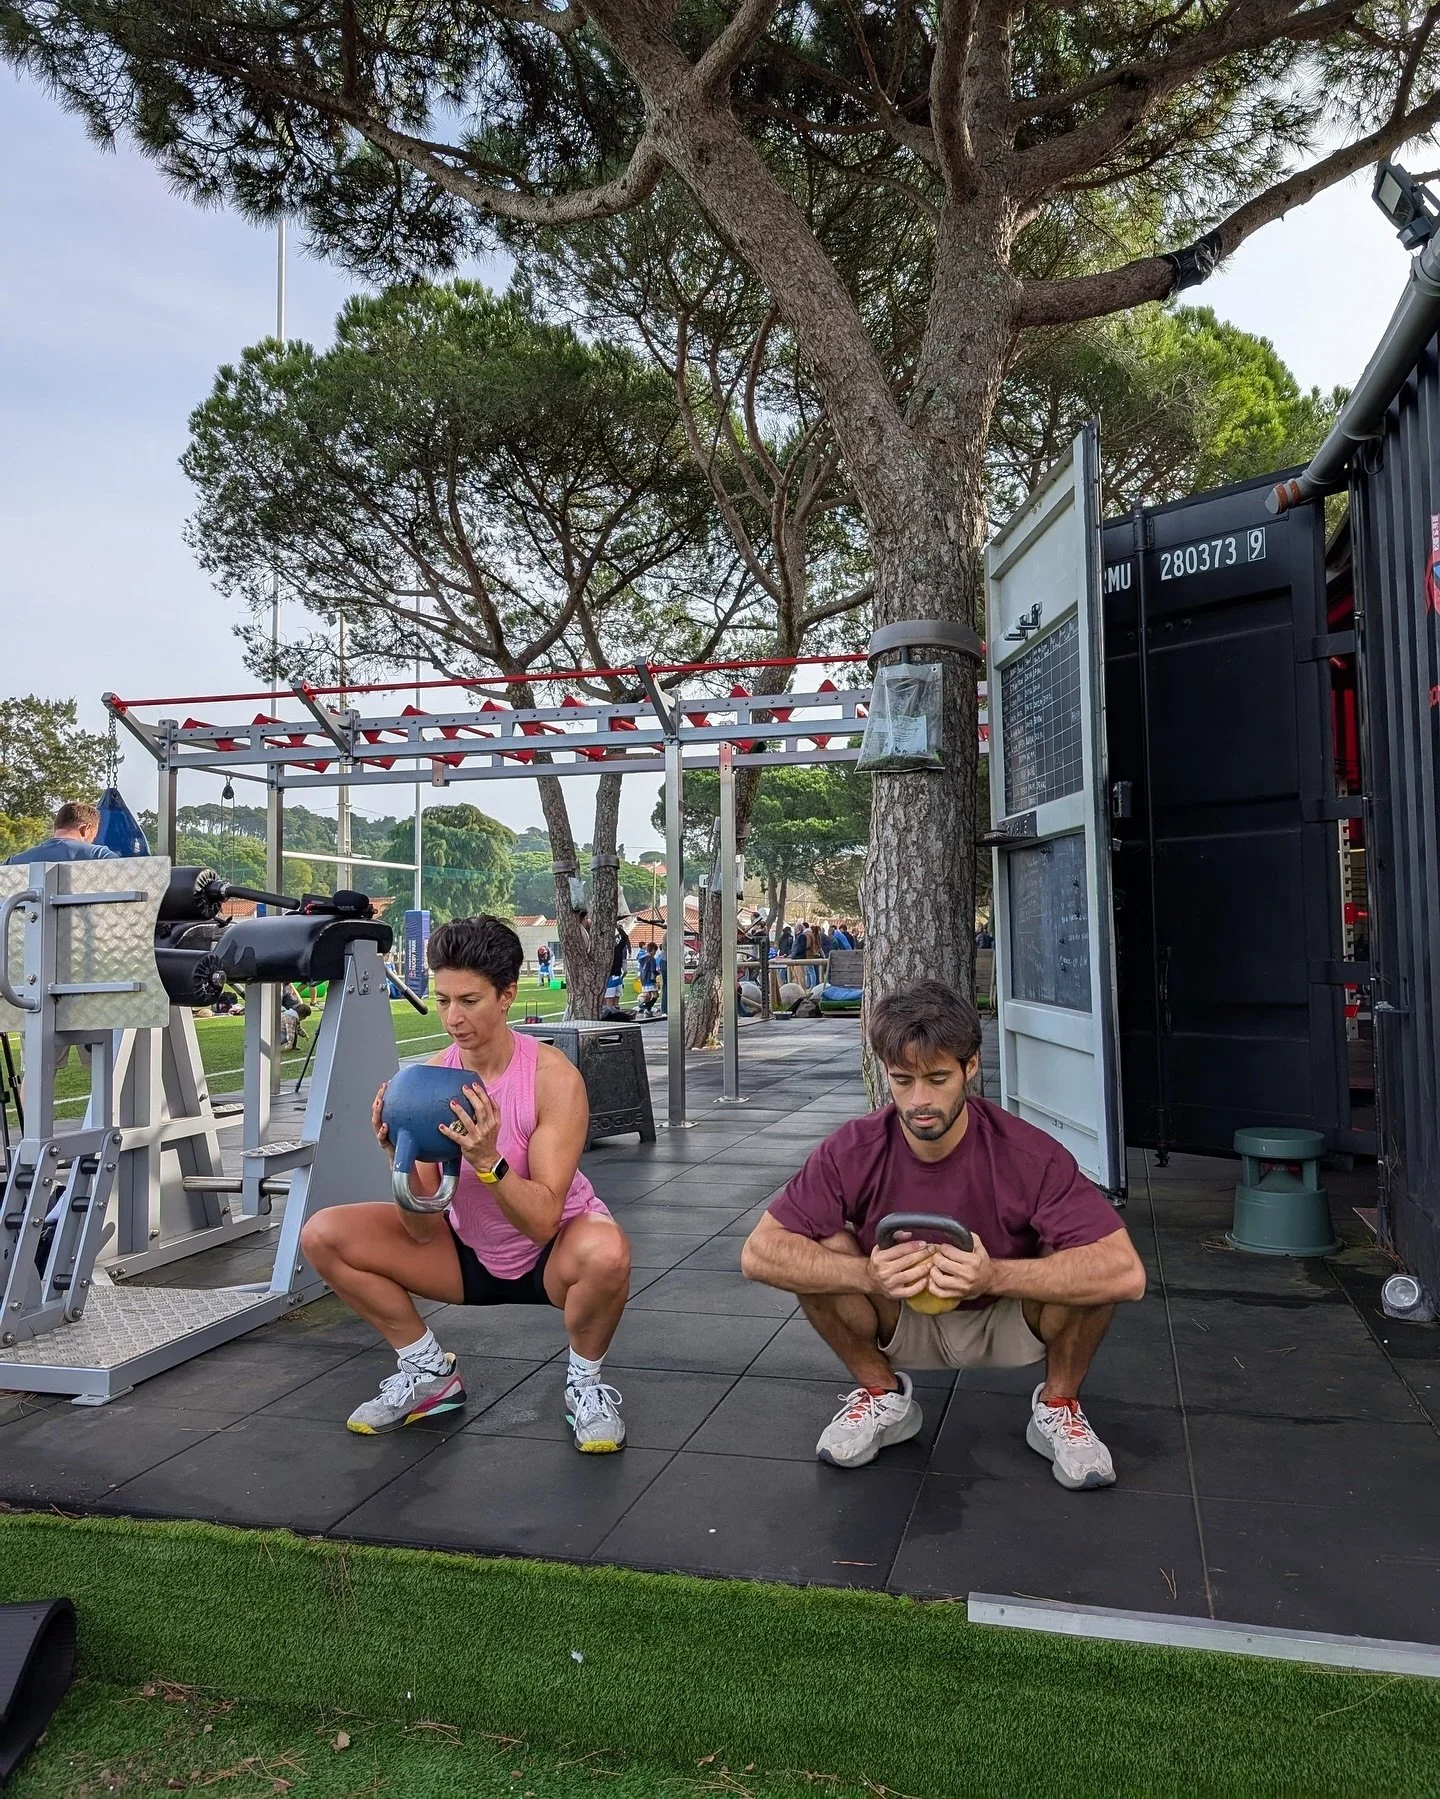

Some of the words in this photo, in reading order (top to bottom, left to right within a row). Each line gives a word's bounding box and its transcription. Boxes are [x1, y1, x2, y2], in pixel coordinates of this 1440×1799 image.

[1103, 562, 1132, 594] MU
[1160, 537, 1237, 581] 280373
[1249, 530, 1264, 560] 9
[590, 1112, 644, 1132] ROGUE
